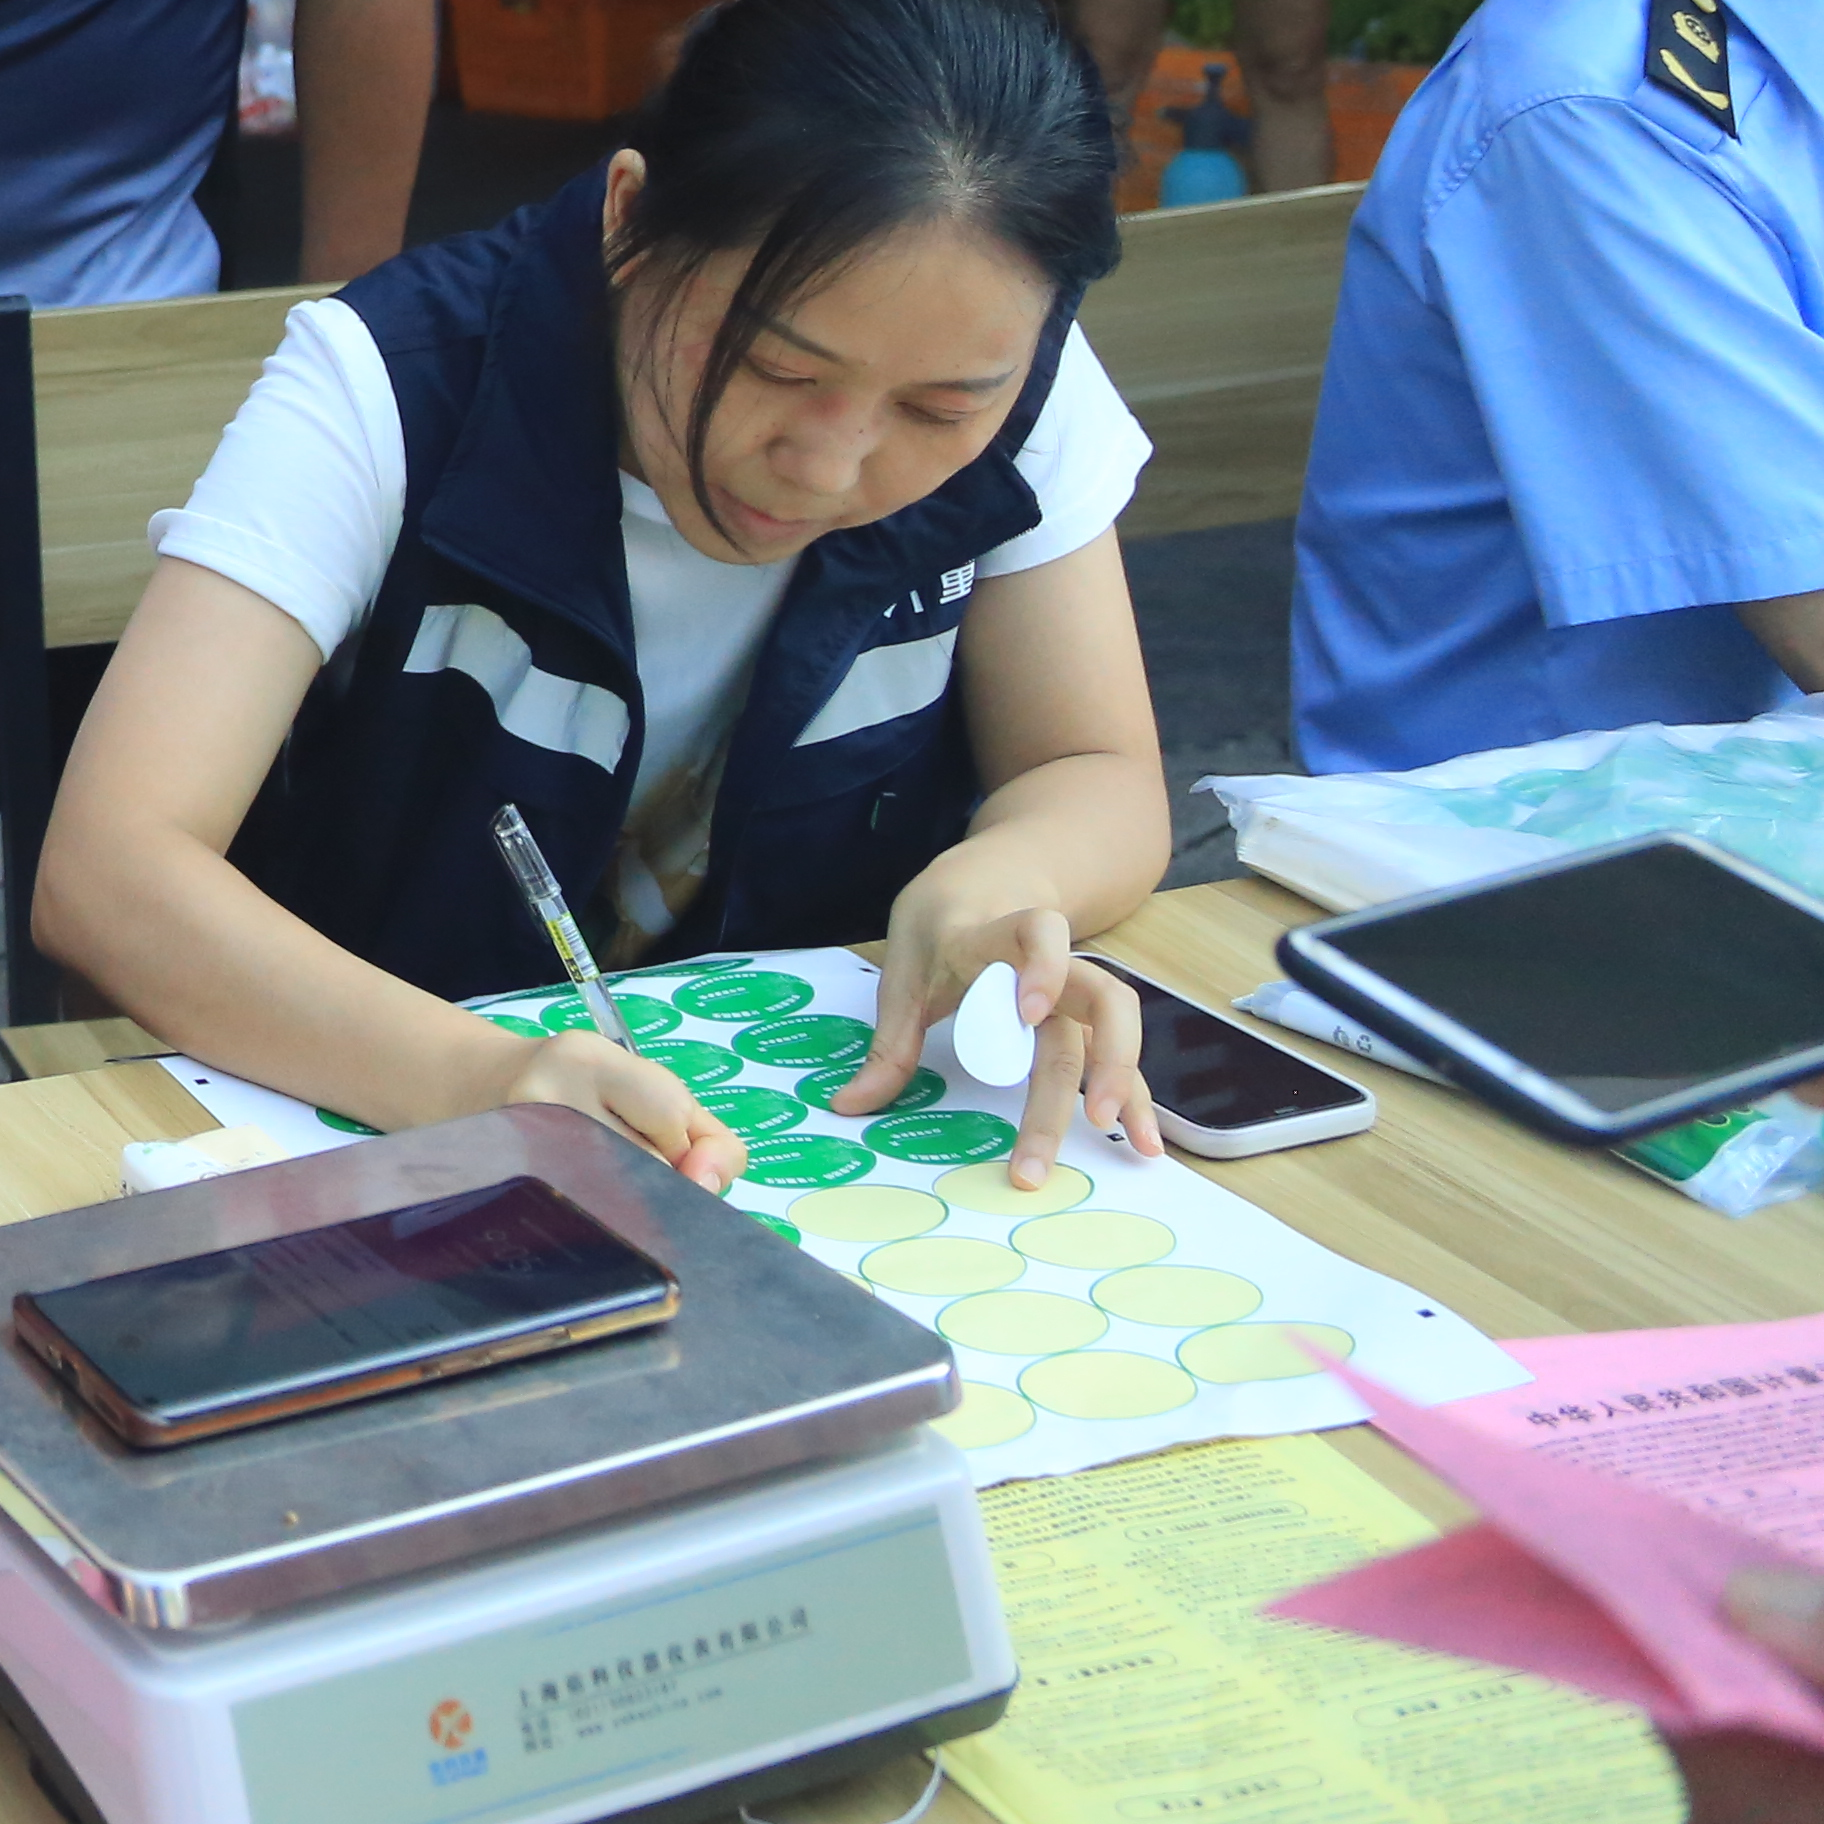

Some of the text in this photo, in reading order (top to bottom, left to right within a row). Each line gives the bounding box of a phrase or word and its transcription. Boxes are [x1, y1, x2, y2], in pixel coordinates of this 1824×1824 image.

[1526, 1362, 1824, 1428] 中华人民共和国计量
